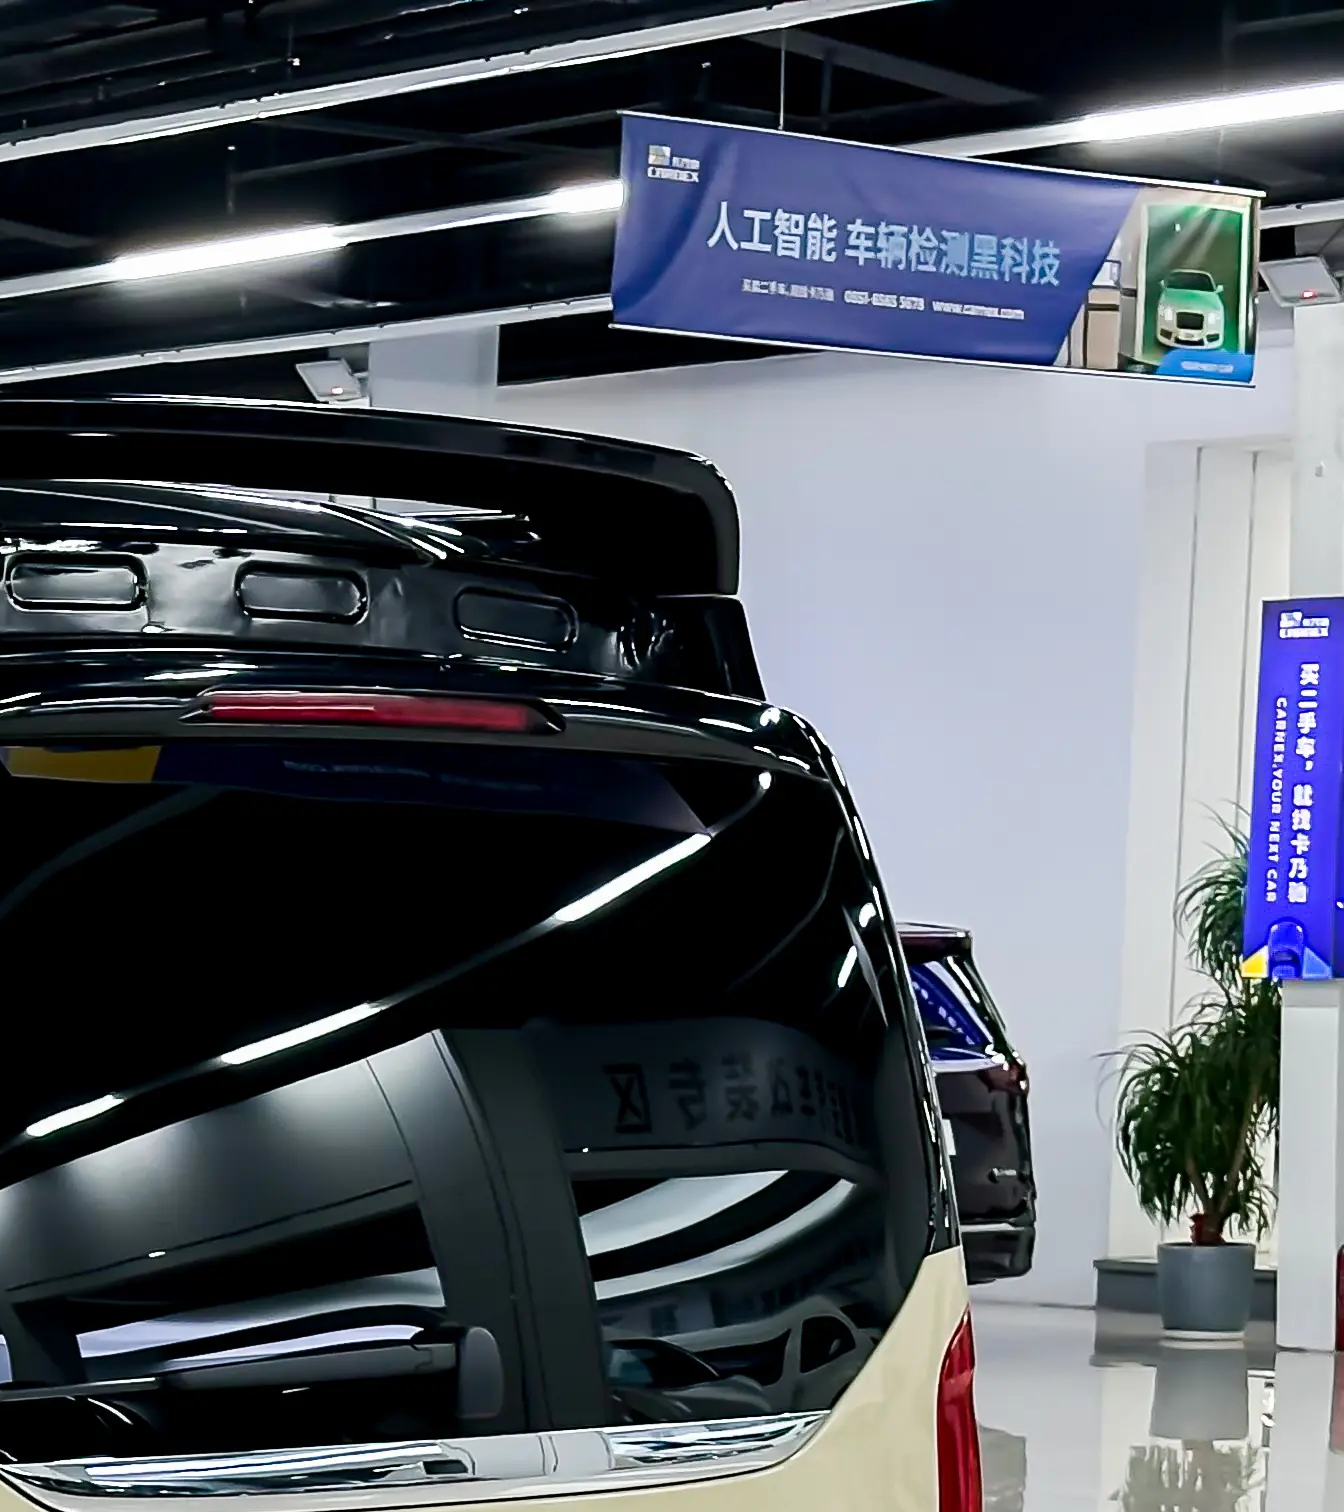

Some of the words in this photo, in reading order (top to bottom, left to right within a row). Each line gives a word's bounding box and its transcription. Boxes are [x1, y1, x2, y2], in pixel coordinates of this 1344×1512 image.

[707, 200, 838, 263] 人工智能
[844, 219, 1061, 287] 车辆检测黑科技
